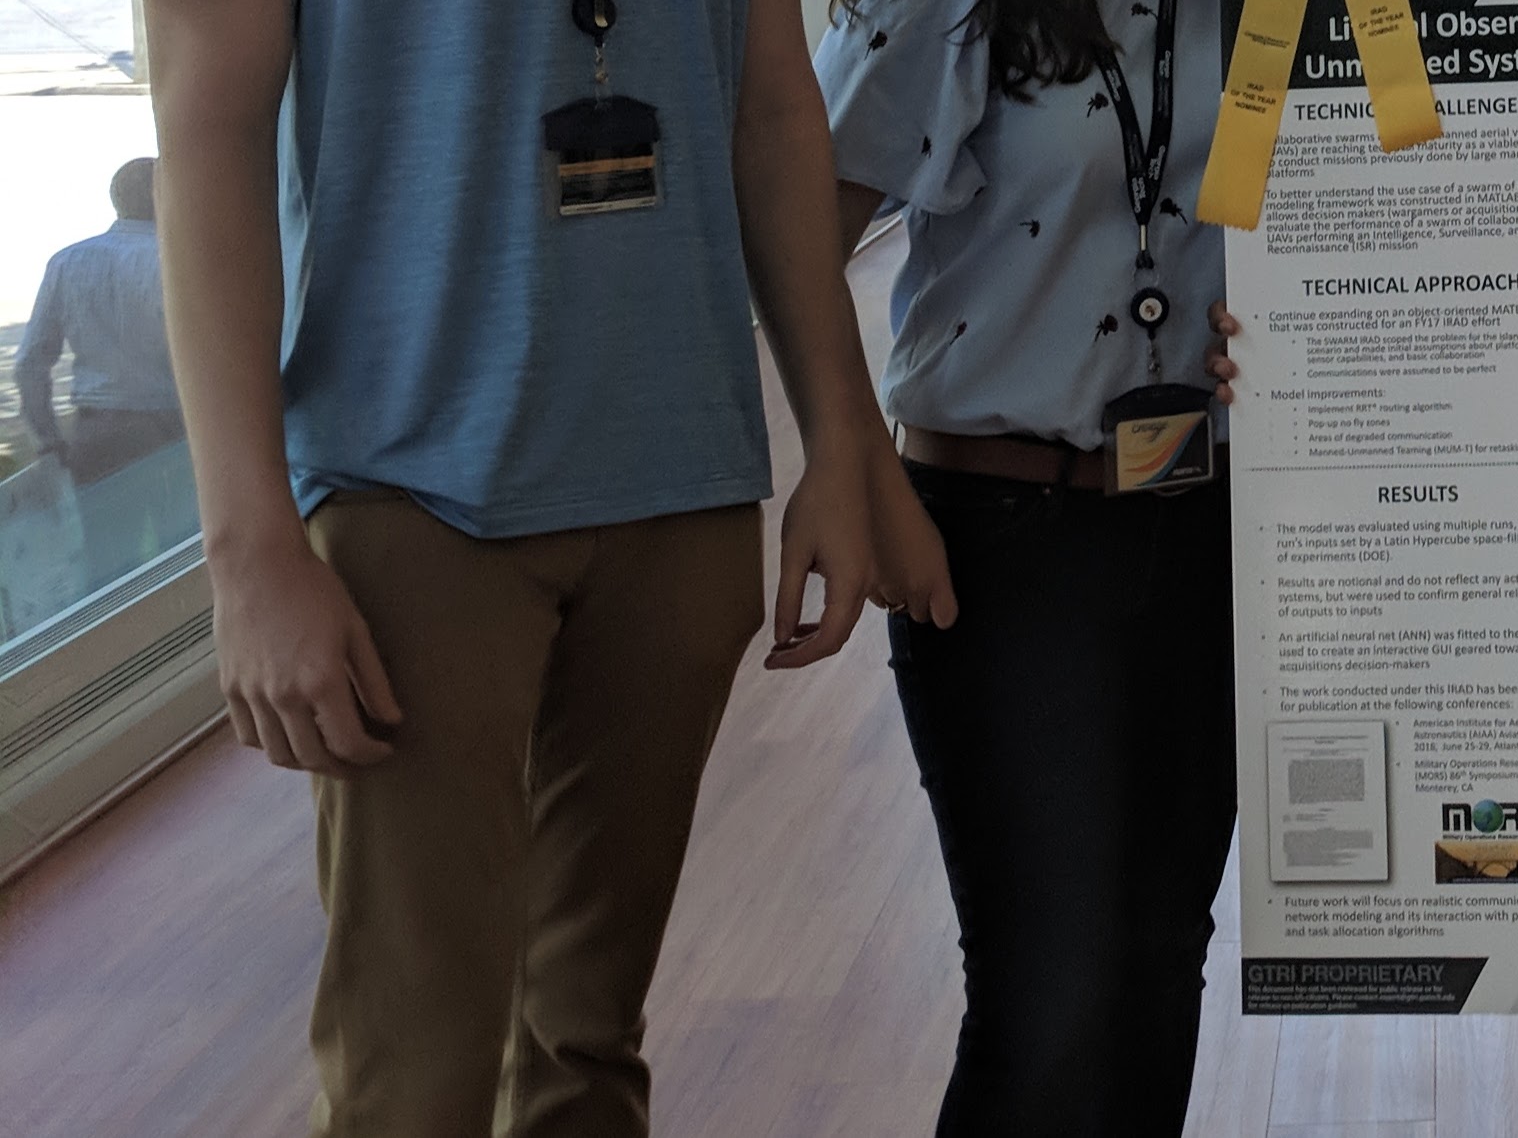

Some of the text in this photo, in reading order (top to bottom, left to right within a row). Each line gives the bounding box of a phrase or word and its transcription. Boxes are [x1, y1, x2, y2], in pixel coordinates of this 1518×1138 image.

[1435, 98, 1518, 116] ALLENGE
[1278, 156, 1319, 167] conduct
[1322, 154, 1367, 166] missions
[1370, 152, 1423, 166] previously
[1426, 151, 1452, 162] done
[1455, 150, 1468, 163] by
[1470, 150, 1496, 163] large
[1266, 188, 1277, 198] To
[1279, 187, 1312, 198] better
[1314, 185, 1374, 197] understand
[1377, 184, 1394, 195] the
[1397, 186, 1415, 194] use
[1418, 186, 1441, 194] case
[1443, 183, 1454, 193] of
[1457, 185, 1463, 193] a
[1466, 184, 1501, 192] swarm
[1504, 181, 1514, 191] of
[1266, 198, 1314, 212] modeling
[1316, 196, 1374, 208] framework
[1376, 198, 1396, 206] was
[1399, 194, 1461, 206] constructed
[1464, 193, 1474, 204] in
[1266, 210, 1298, 221] allows
[1301, 208, 1344, 220] decision
[1347, 207, 1384, 218] makers
[1387, 205, 1448, 219] (wargamers
[1450, 207, 1462, 215] or
[1267, 220, 1310, 231] evaluate
[1312, 219, 1330, 230] the
[1333, 217, 1400, 232] performance
[1402, 217, 1414, 227] of
[1417, 219, 1423, 227] a
[1426, 218, 1461, 226] swarm
[1463, 215, 1474, 225] of
[1267, 232, 1293, 242] UAVs
[1296, 230, 1354, 244] performing
[1357, 232, 1370, 240] an
[1372, 228, 1435, 242] Intelligence,
[1438, 226, 1504, 238] Surveillance,
[1268, 238, 1418, 253] Reconnaissance (ISR) mission
[1302, 277, 1408, 296] TECHNICAL
[1269, 309, 1316, 320] Continue
[1318, 308, 1372, 321] expanding
[1375, 310, 1389, 318] on
[1392, 309, 1405, 317] an
[1270, 315, 1500, 332] that was constructed for an FY17 IRAD effort
[1307, 366, 1377, 377] Communications
[1402, 364, 1440, 374] assumed
[1442, 364, 1451, 373] to
[1453, 363, 1464, 373] be
[1466, 362, 1496, 374] perfect
[1378, 485, 1459, 503] RESULTS
[1276, 522, 1296, 532] The
[1298, 522, 1332, 532] model
[1334, 524, 1355, 532] was
[1357, 520, 1409, 531] evaluated
[1412, 520, 1440, 532] using
[1443, 519, 1487, 532] multiple
[1490, 521, 1516, 530] runs,
[1285, 896, 1319, 906] Future
[1321, 896, 1349, 906] work
[1351, 896, 1370, 906] will
[1373, 896, 1401, 906] focus
[1404, 898, 1418, 906] on
[1421, 896, 1462, 906] realistic
[1248, 965, 1444, 982] GTRI PROPRIETARY
